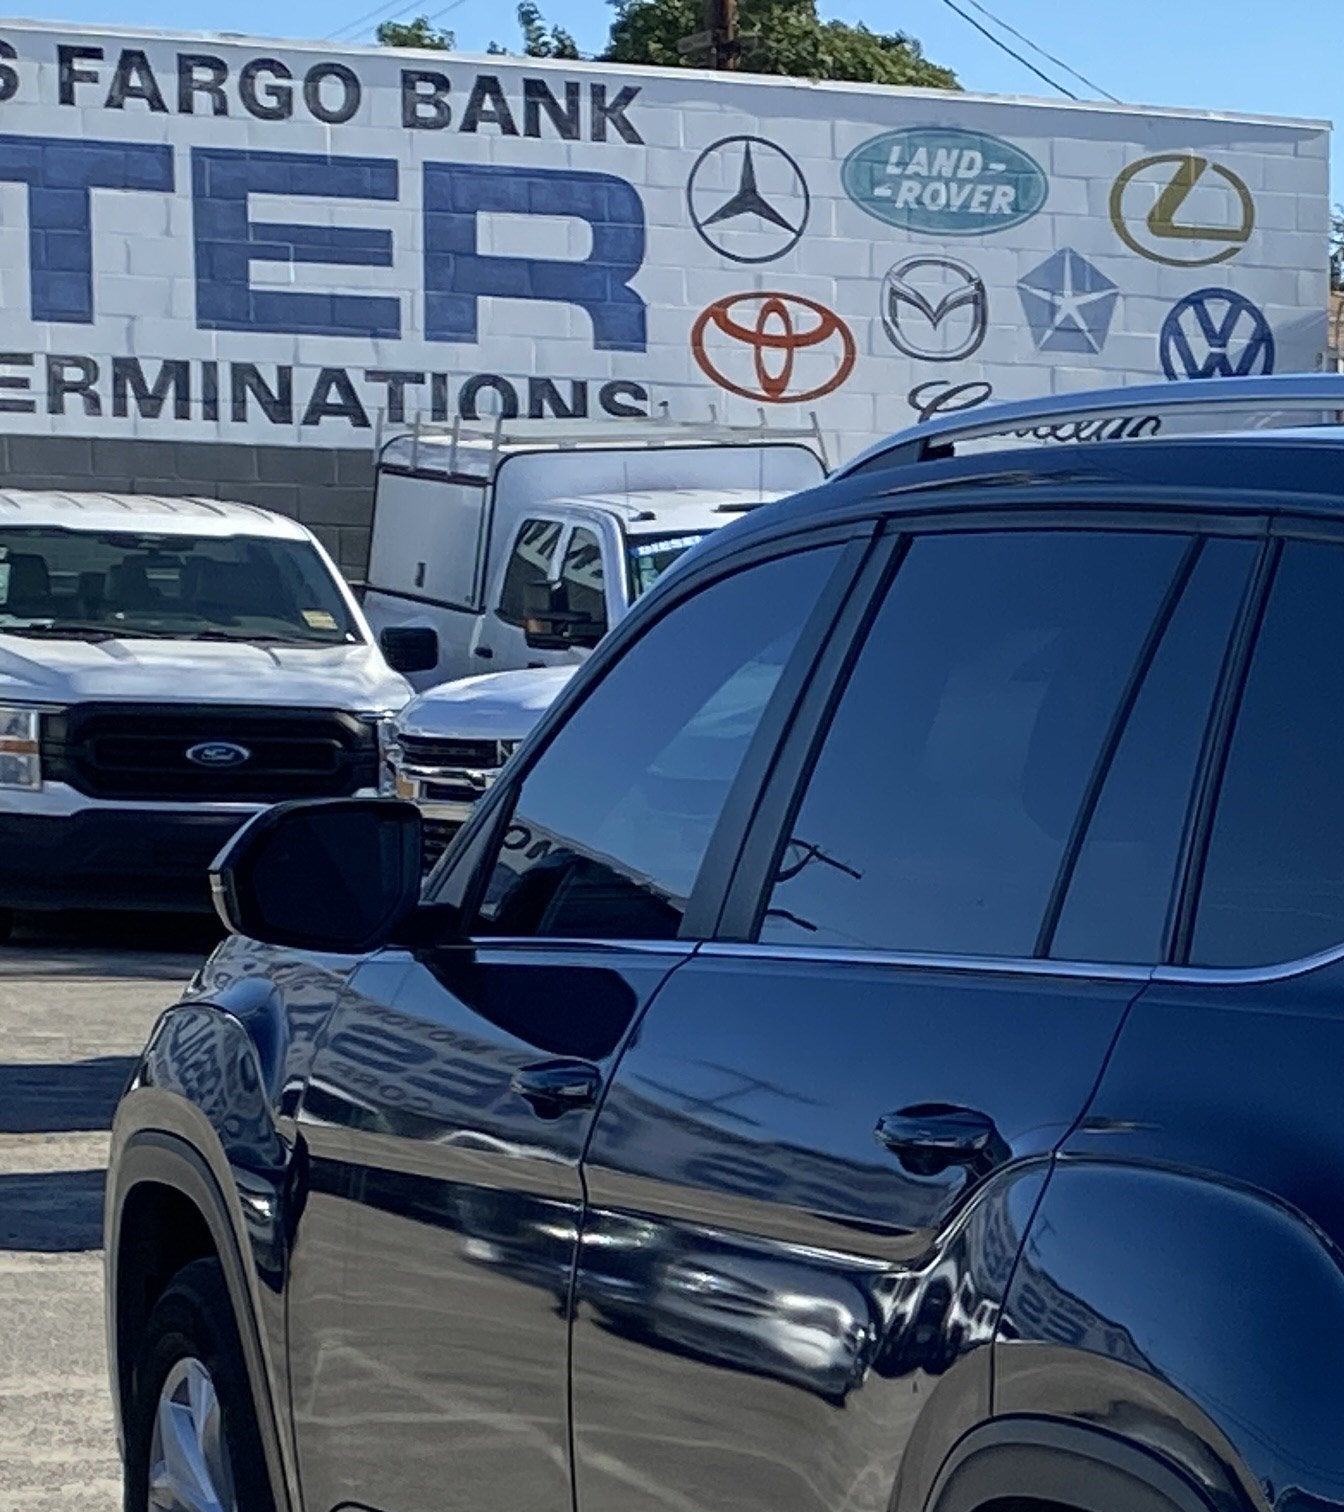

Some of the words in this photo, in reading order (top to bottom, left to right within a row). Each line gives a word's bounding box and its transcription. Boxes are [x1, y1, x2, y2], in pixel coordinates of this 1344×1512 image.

[57, 44, 362, 123] FARGO
[401, 69, 645, 145] BANK
[0, 134, 647, 353] TER
